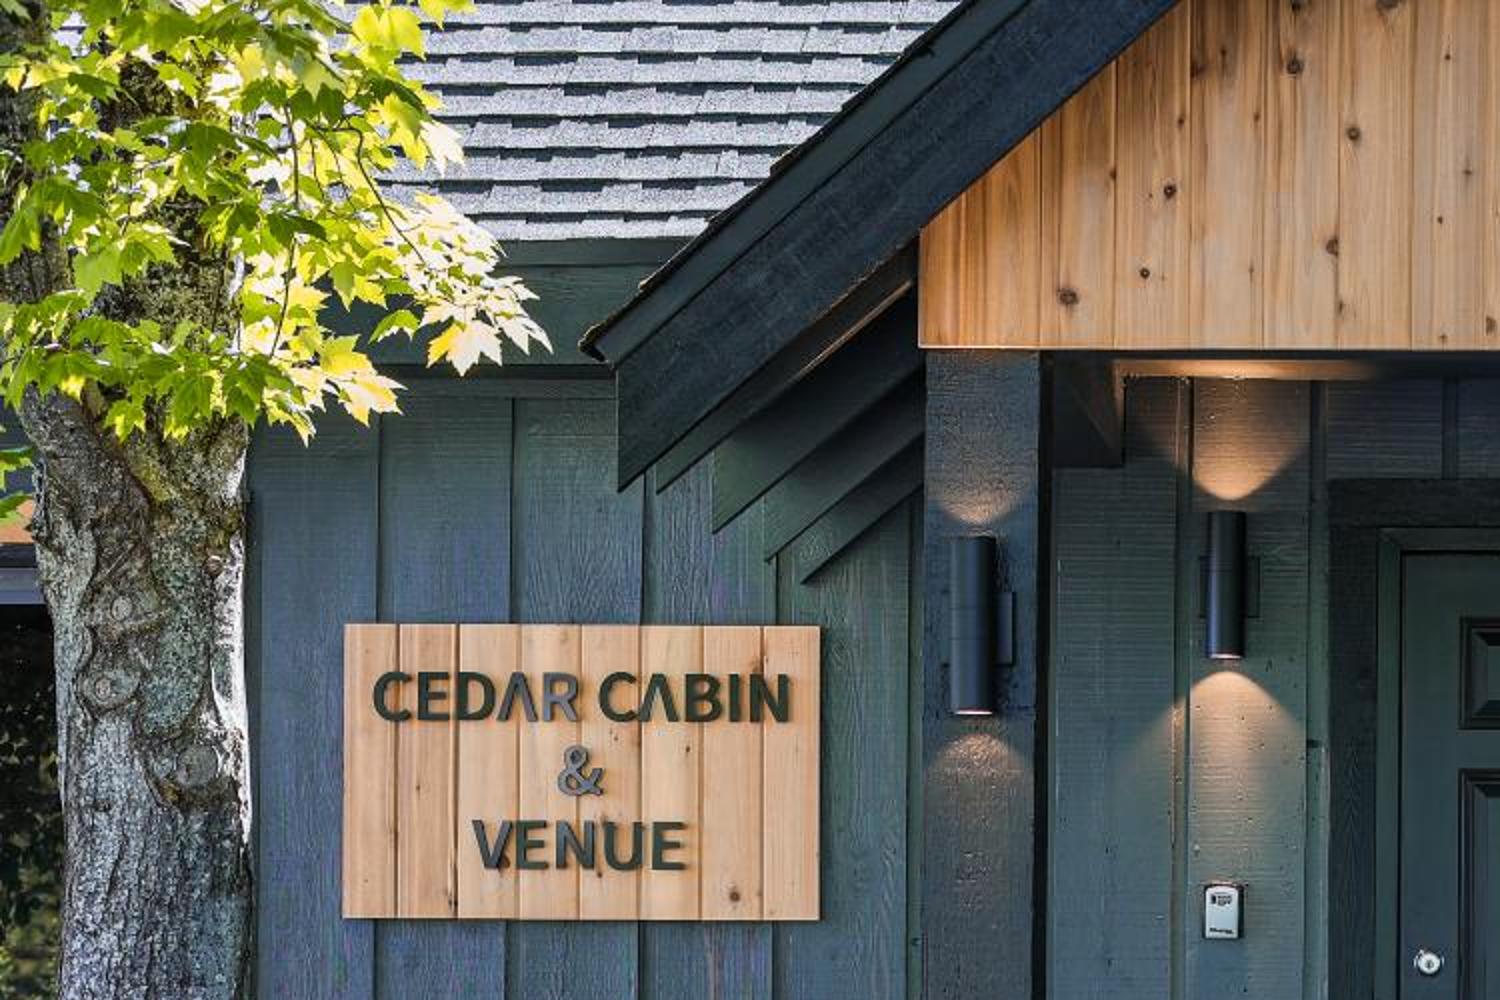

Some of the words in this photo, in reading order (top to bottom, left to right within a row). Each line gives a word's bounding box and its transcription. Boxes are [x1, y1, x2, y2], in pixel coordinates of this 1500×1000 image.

[373, 671, 579, 723] CEDAR
[598, 671, 790, 723] CABIN
[557, 745, 604, 797] &
[472, 819, 687, 871] VENUE
